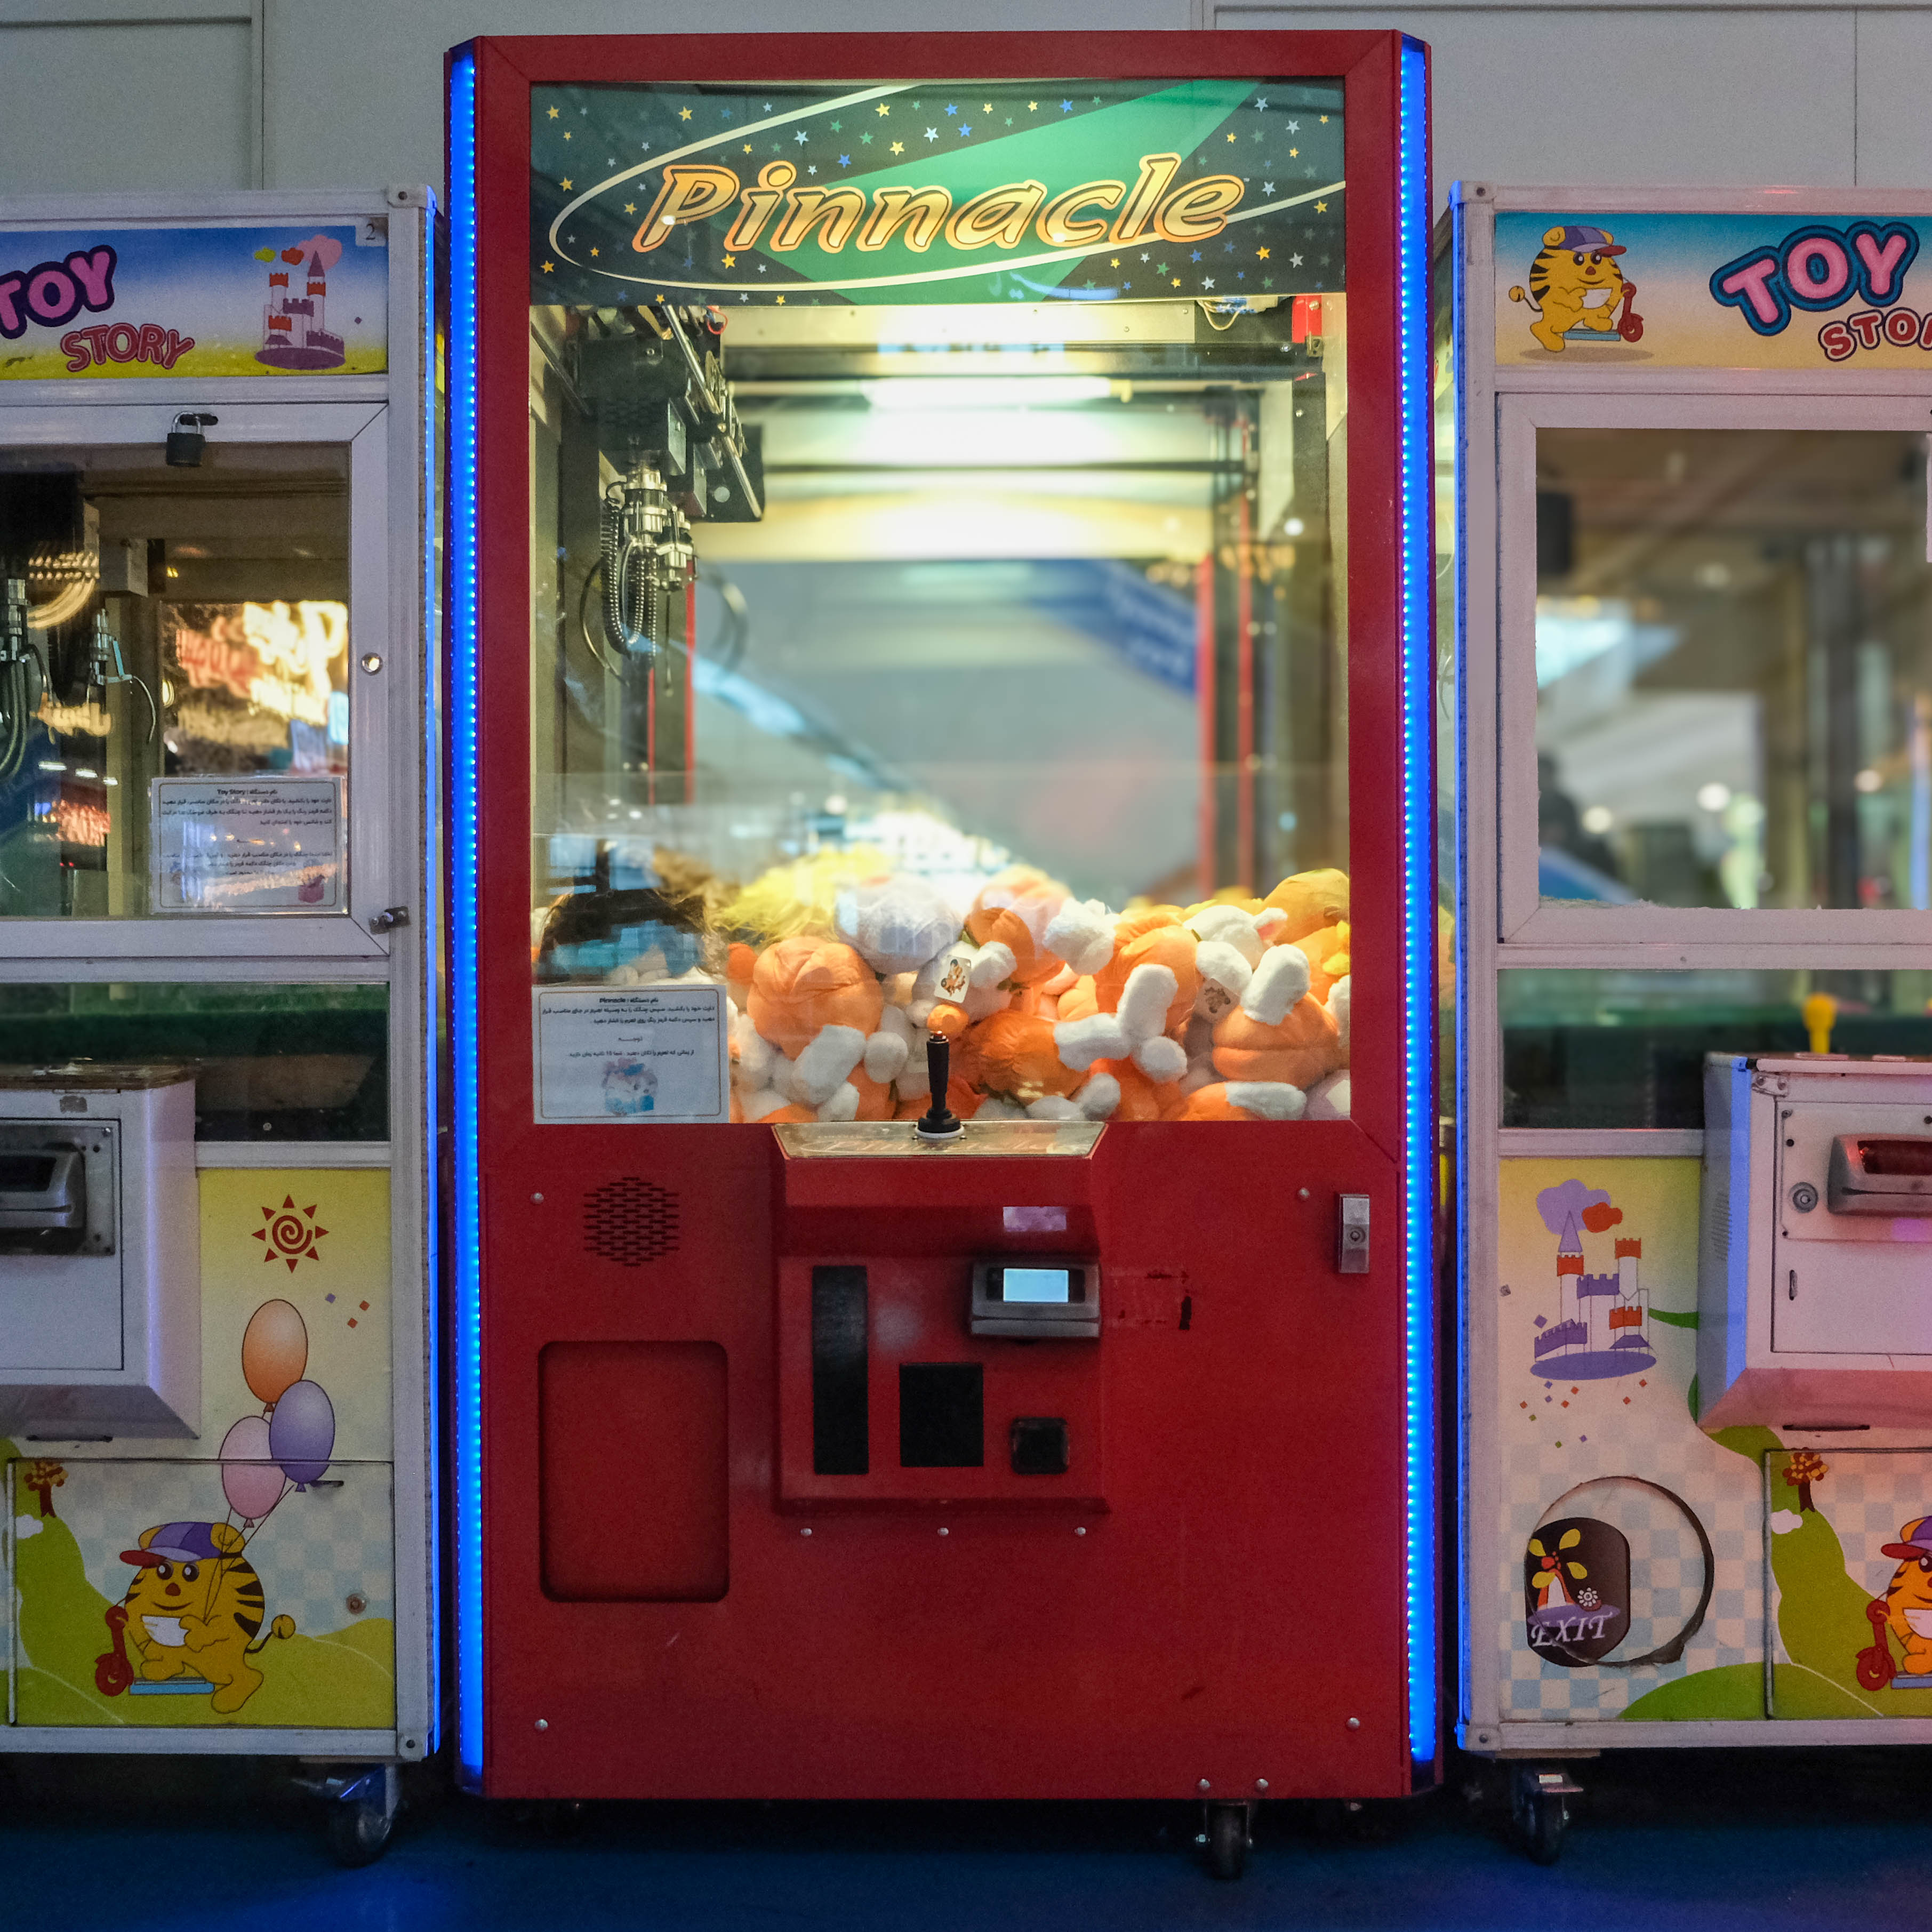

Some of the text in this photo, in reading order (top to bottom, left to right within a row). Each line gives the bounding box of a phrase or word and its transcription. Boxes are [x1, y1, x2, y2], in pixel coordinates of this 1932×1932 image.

[366, 223, 375, 240] 2
[631, 153, 1245, 253] Pinnacle
[0, 245, 117, 339] TOY
[1709, 220, 1920, 336] TOY
[60, 322, 195, 372] STORY
[1530, 1611, 1614, 1647] EXIT
